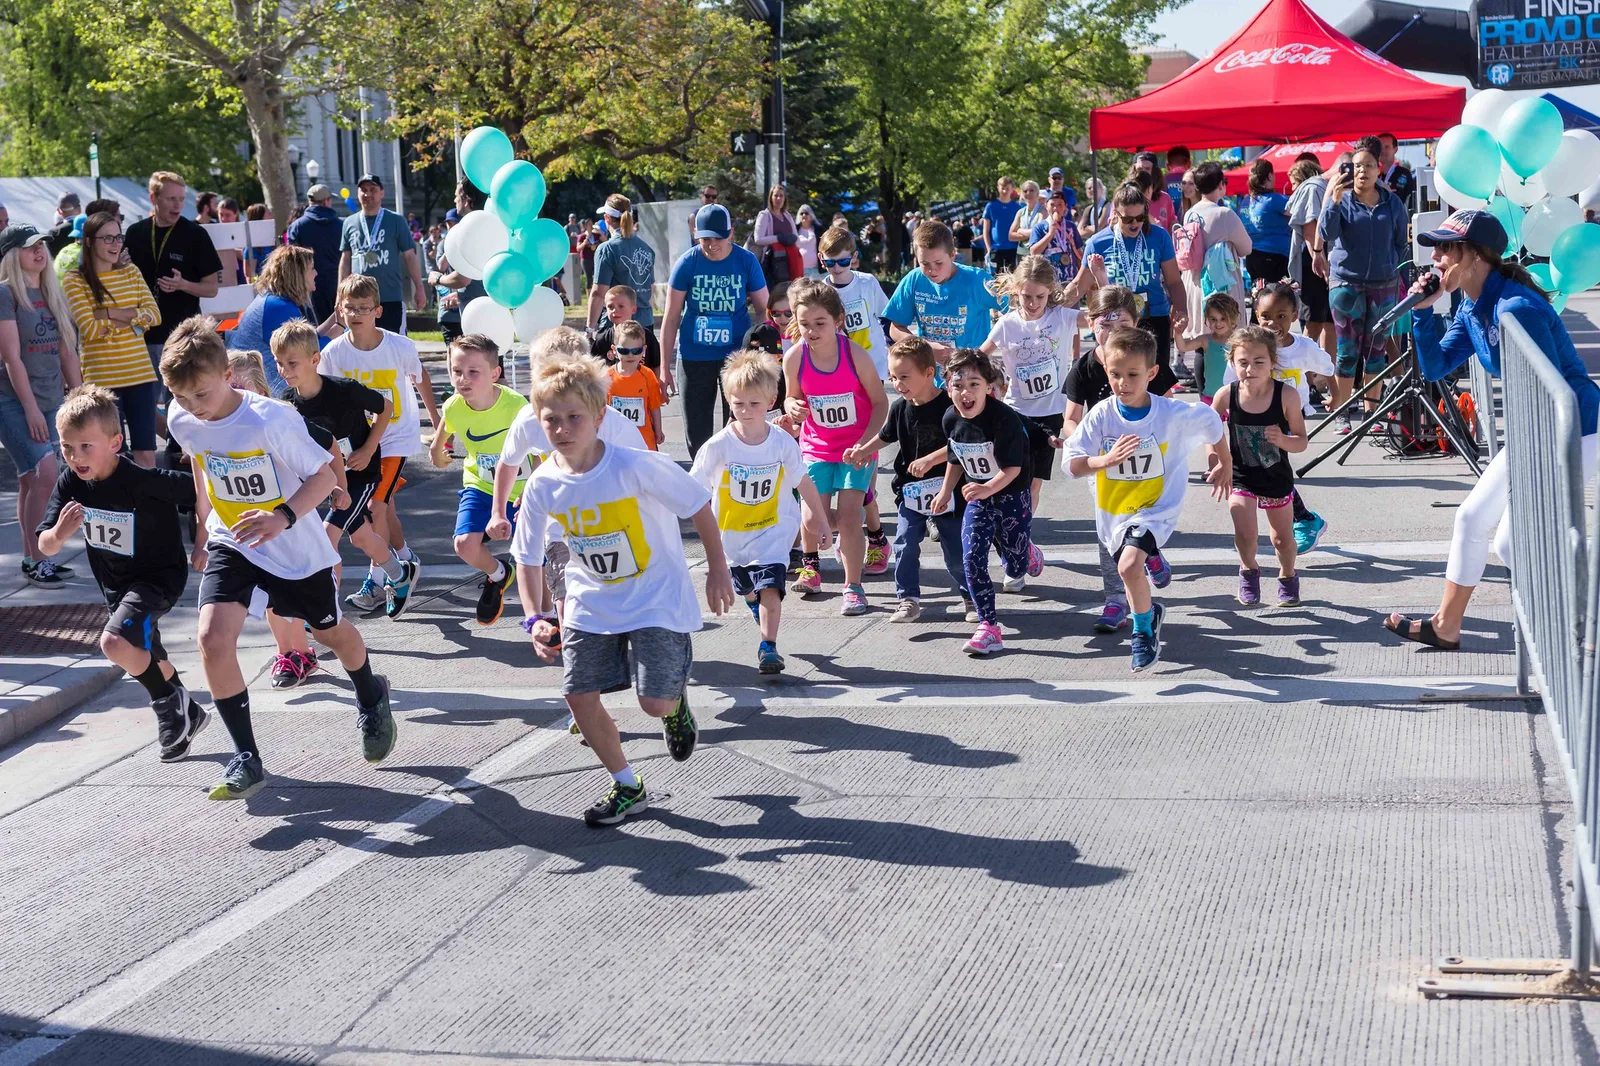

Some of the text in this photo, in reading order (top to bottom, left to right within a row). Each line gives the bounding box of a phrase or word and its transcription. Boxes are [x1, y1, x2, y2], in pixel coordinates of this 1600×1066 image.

[1481, 15, 1582, 47] PROVO
[1484, 39, 1600, 61] HALF MARA
[1559, 55, 1579, 70] 5K
[1521, 67, 1600, 84] KIDS MARATH
[691, 286, 741, 301] SHALT
[699, 300, 735, 312] RUN
[846, 311, 863, 328] 03
[697, 328, 730, 343] 1576
[1025, 373, 1053, 394] 102
[816, 406, 849, 424] 100
[229, 459, 266, 471] PROVO CITY
[221, 473, 266, 496] 109
[739, 479, 772, 499] 116
[915, 491, 940, 510] 12
[83, 522, 122, 548] 112
[583, 537, 622, 548] PROVO CITY
[578, 552, 619, 575] 107
